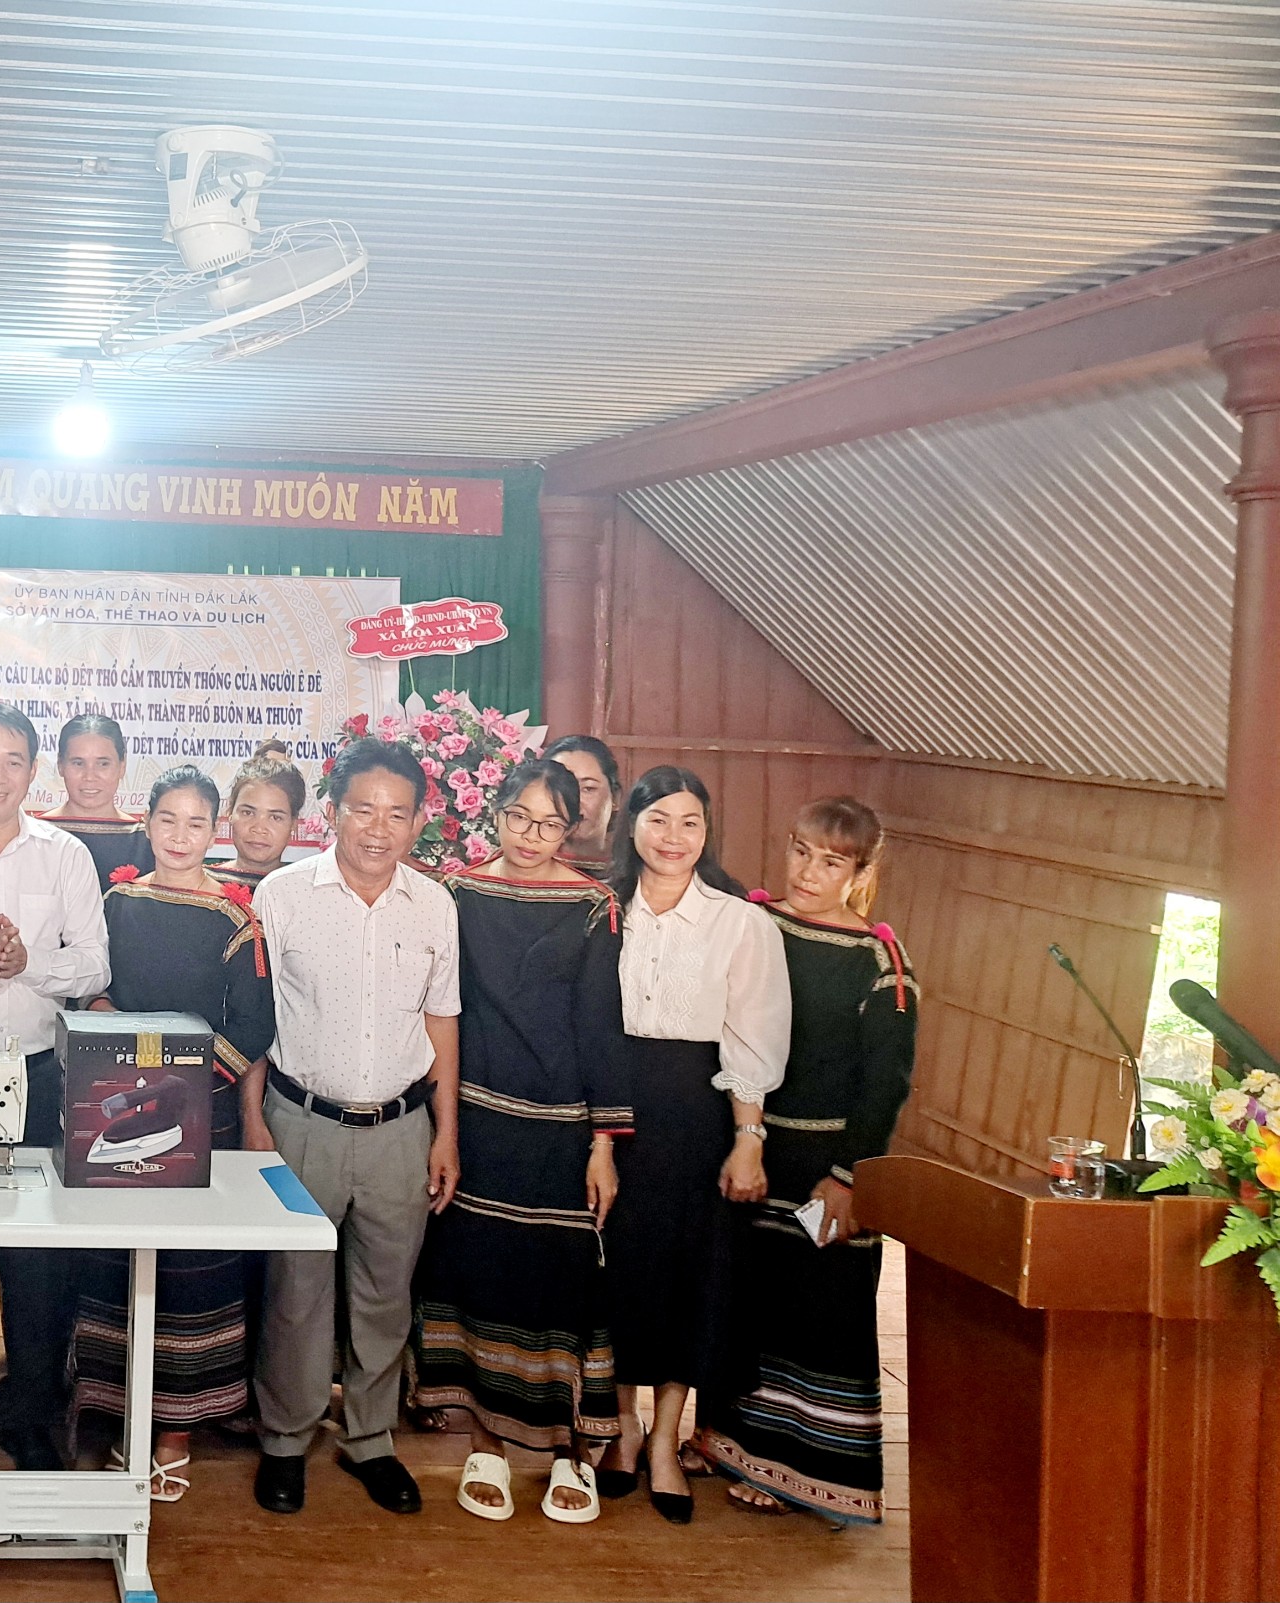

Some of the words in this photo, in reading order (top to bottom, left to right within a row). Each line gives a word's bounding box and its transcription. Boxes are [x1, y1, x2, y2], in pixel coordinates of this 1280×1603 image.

[26, 466, 150, 513] QUANG
[157, 475, 242, 516] VINH
[252, 473, 360, 522] MUÔN
[377, 477, 459, 525] NĂM
[14, 583, 34, 598] ỦY
[39, 588, 69, 600] BAN
[74, 587, 115, 601] NHÂN
[120, 588, 151, 602] DÂN
[156, 588, 190, 603] TỈNH
[195, 589, 225, 605] ĐẮK
[230, 589, 258, 605] LẮK
[6, 602, 26, 616] SỞ
[30, 604, 60, 618] VĂN
[65, 605, 100, 621] HÓA,
[105, 603, 134, 620] THỂ
[138, 609, 178, 621] THAO
[183, 608, 202, 622] VÀ
[206, 611, 227, 623] DU
[231, 612, 265, 626] LỊCH
[378, 629, 398, 642] XÃ
[391, 639, 427, 653] CHÚC
[31, 665, 52, 690] LẠC
[55, 662, 70, 691] BỘ
[72, 662, 94, 691] DỆT
[96, 659, 118, 687] THỔ
[194, 664, 231, 691] THỐNG
[234, 665, 258, 691] CỦA
[260, 668, 296, 692] NGƯỜI
[298, 669, 305, 693] Ê
[307, 669, 323, 693] ĐÊ
[66, 696, 80, 719] XÃ
[111, 697, 145, 725] XUÂN,
[148, 699, 185, 723] THÀNH
[188, 697, 210, 723] PHỐ
[213, 701, 244, 725] BUÔN
[246, 706, 263, 725] MA
[266, 702, 303, 731] THUỘT
[132, 730, 154, 760] DỆT
[157, 727, 179, 756] THỔ
[296, 733, 318, 760] CỦA
[36, 789, 53, 804] Ma
[130, 792, 145, 806] 02
